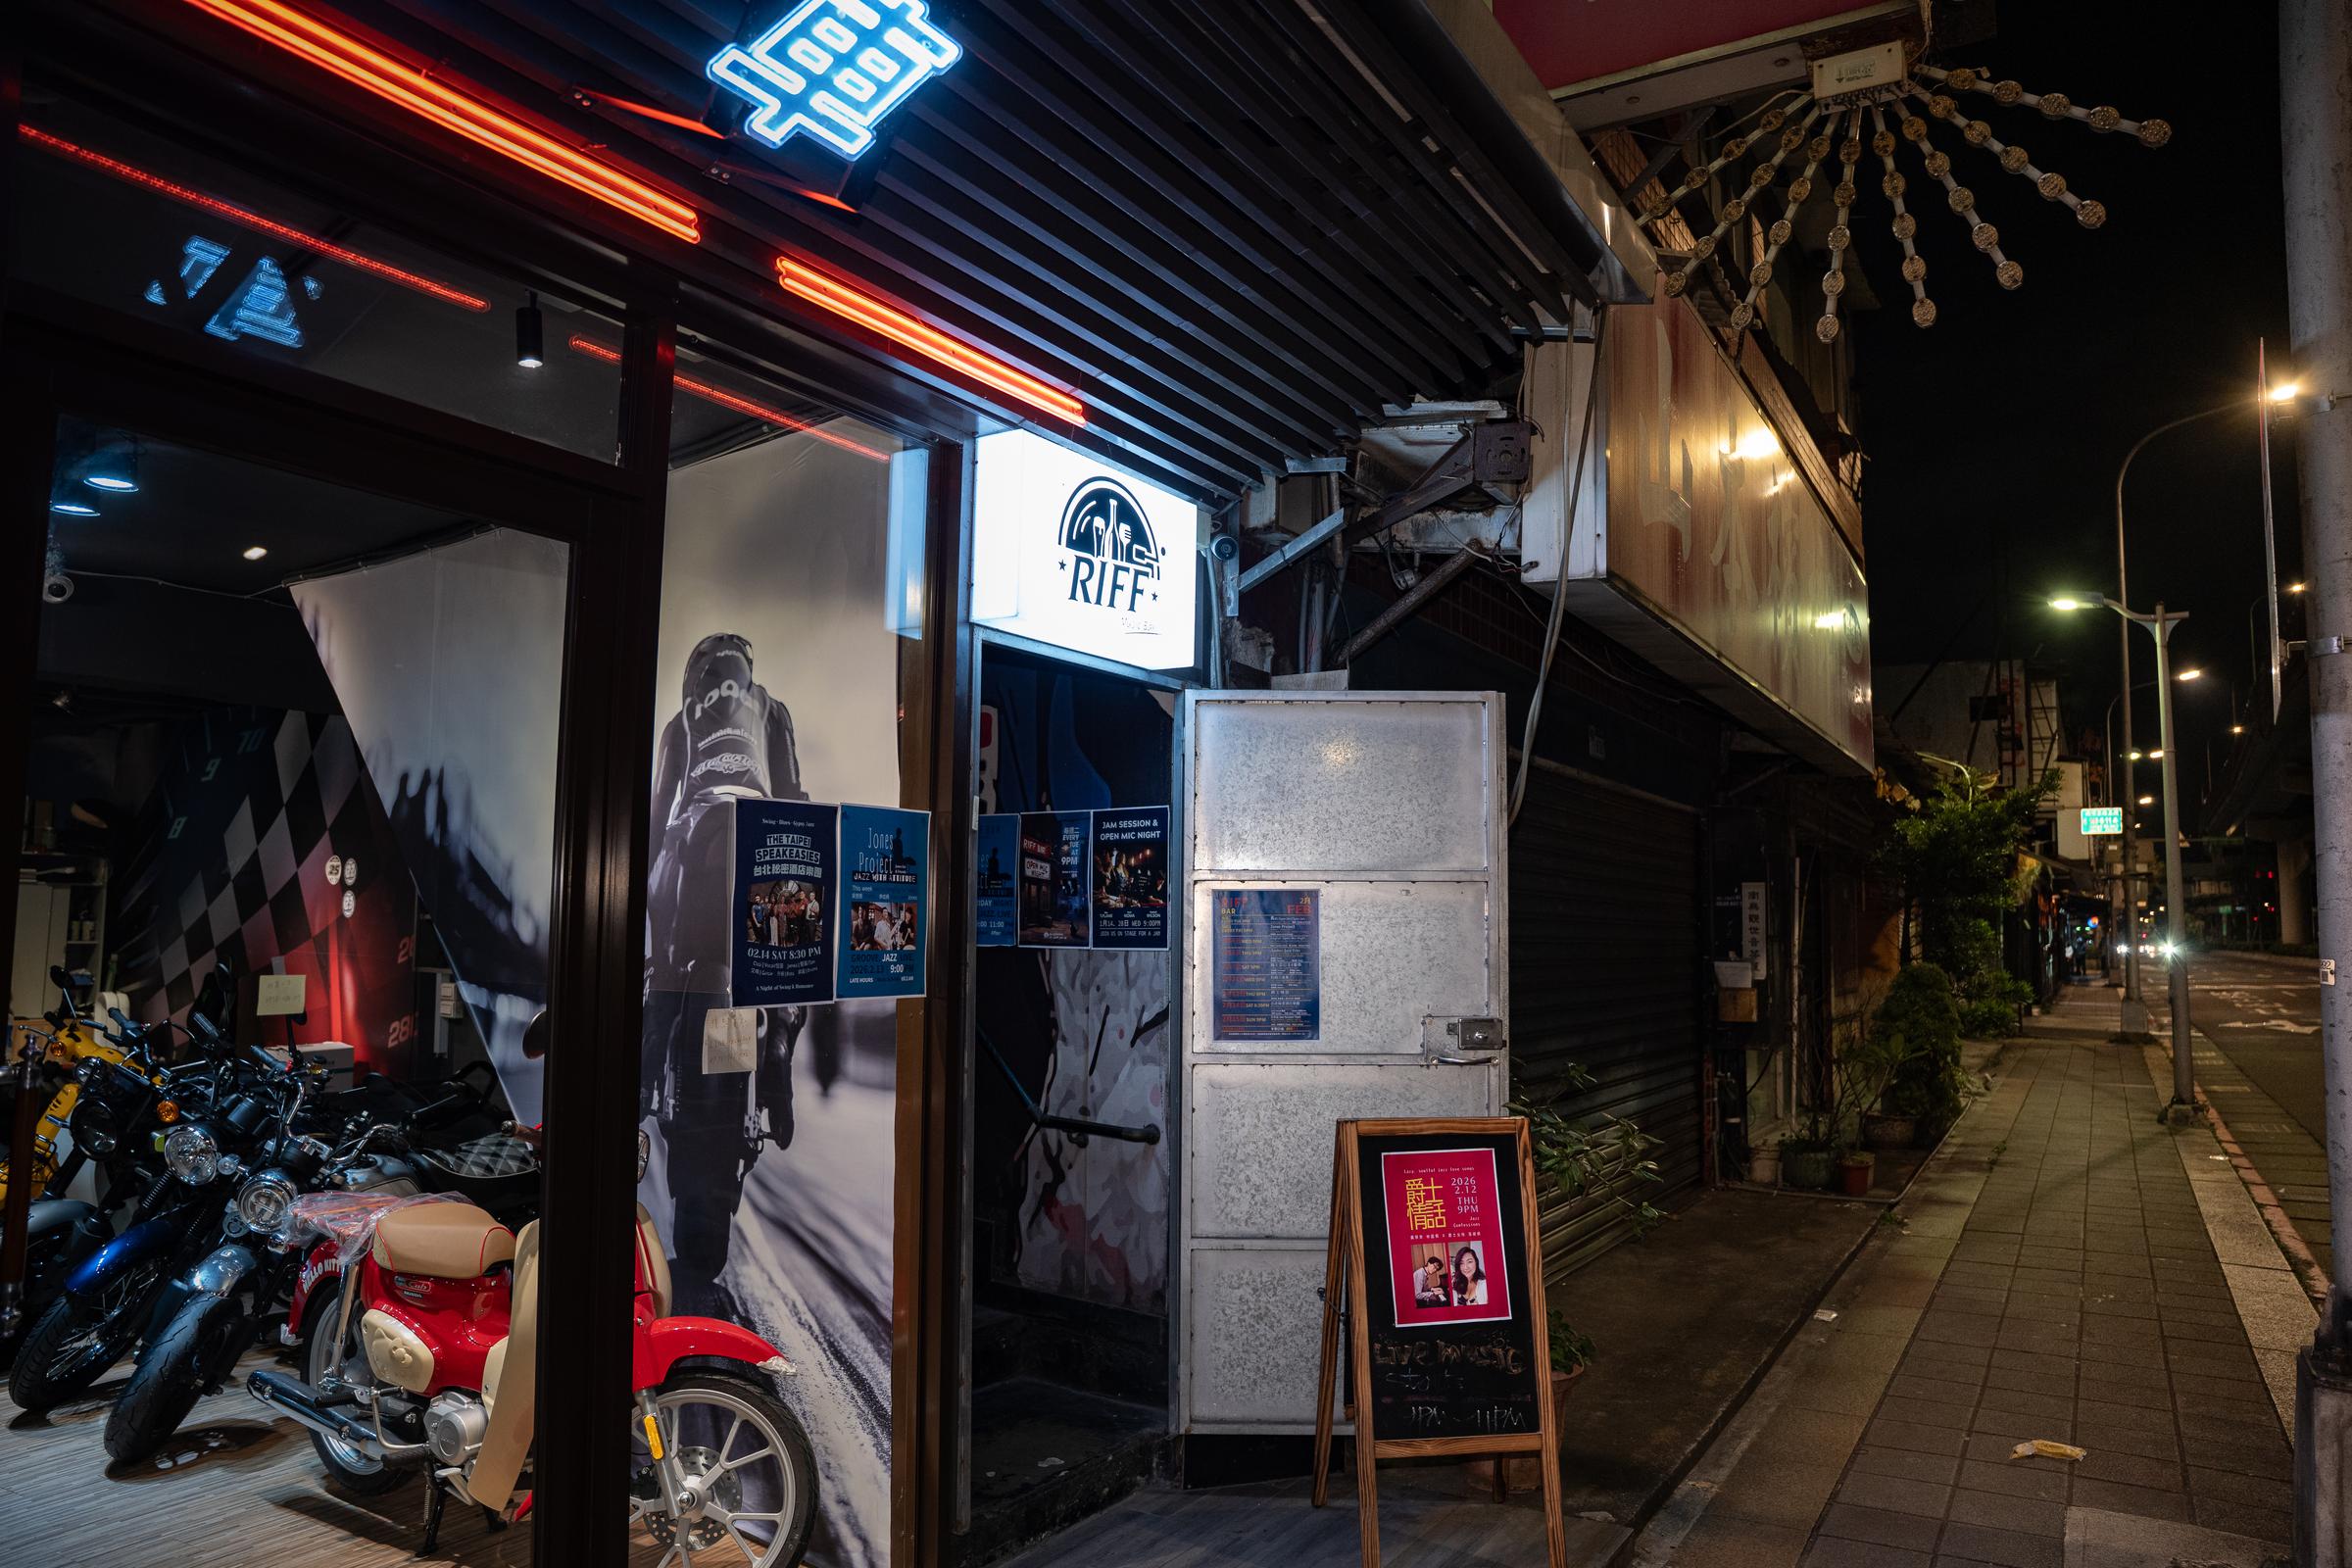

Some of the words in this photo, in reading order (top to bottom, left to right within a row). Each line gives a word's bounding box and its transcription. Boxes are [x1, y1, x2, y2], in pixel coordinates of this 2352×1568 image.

[1068, 554, 1150, 612] RIFF
[1102, 820, 1117, 829] JAM
[1118, 819, 1152, 828] SESSION
[1152, 818, 1158, 827] &
[767, 834, 784, 845] THE
[785, 834, 811, 847] TAIPEI
[868, 827, 894, 851] Jones
[756, 848, 820, 863] SPEAKEASIES
[1060, 857, 1078, 865] 9PM
[859, 852, 893, 876] Project
[854, 872, 870, 881] JAZZ
[889, 874, 916, 883] ATTITUDE
[748, 948, 769, 959] 02.14
[771, 951, 788, 960] SAT
[789, 950, 807, 959] 8:30
[808, 946, 821, 957] PM
[882, 953, 898, 962] JAZZ
[890, 963, 905, 973] 9:00
[1450, 1176, 1476, 1187] 2026
[1454, 1185, 1477, 1195] 2.12
[1456, 1196, 1478, 1205] THU
[1457, 1204, 1479, 1214] 9PM
